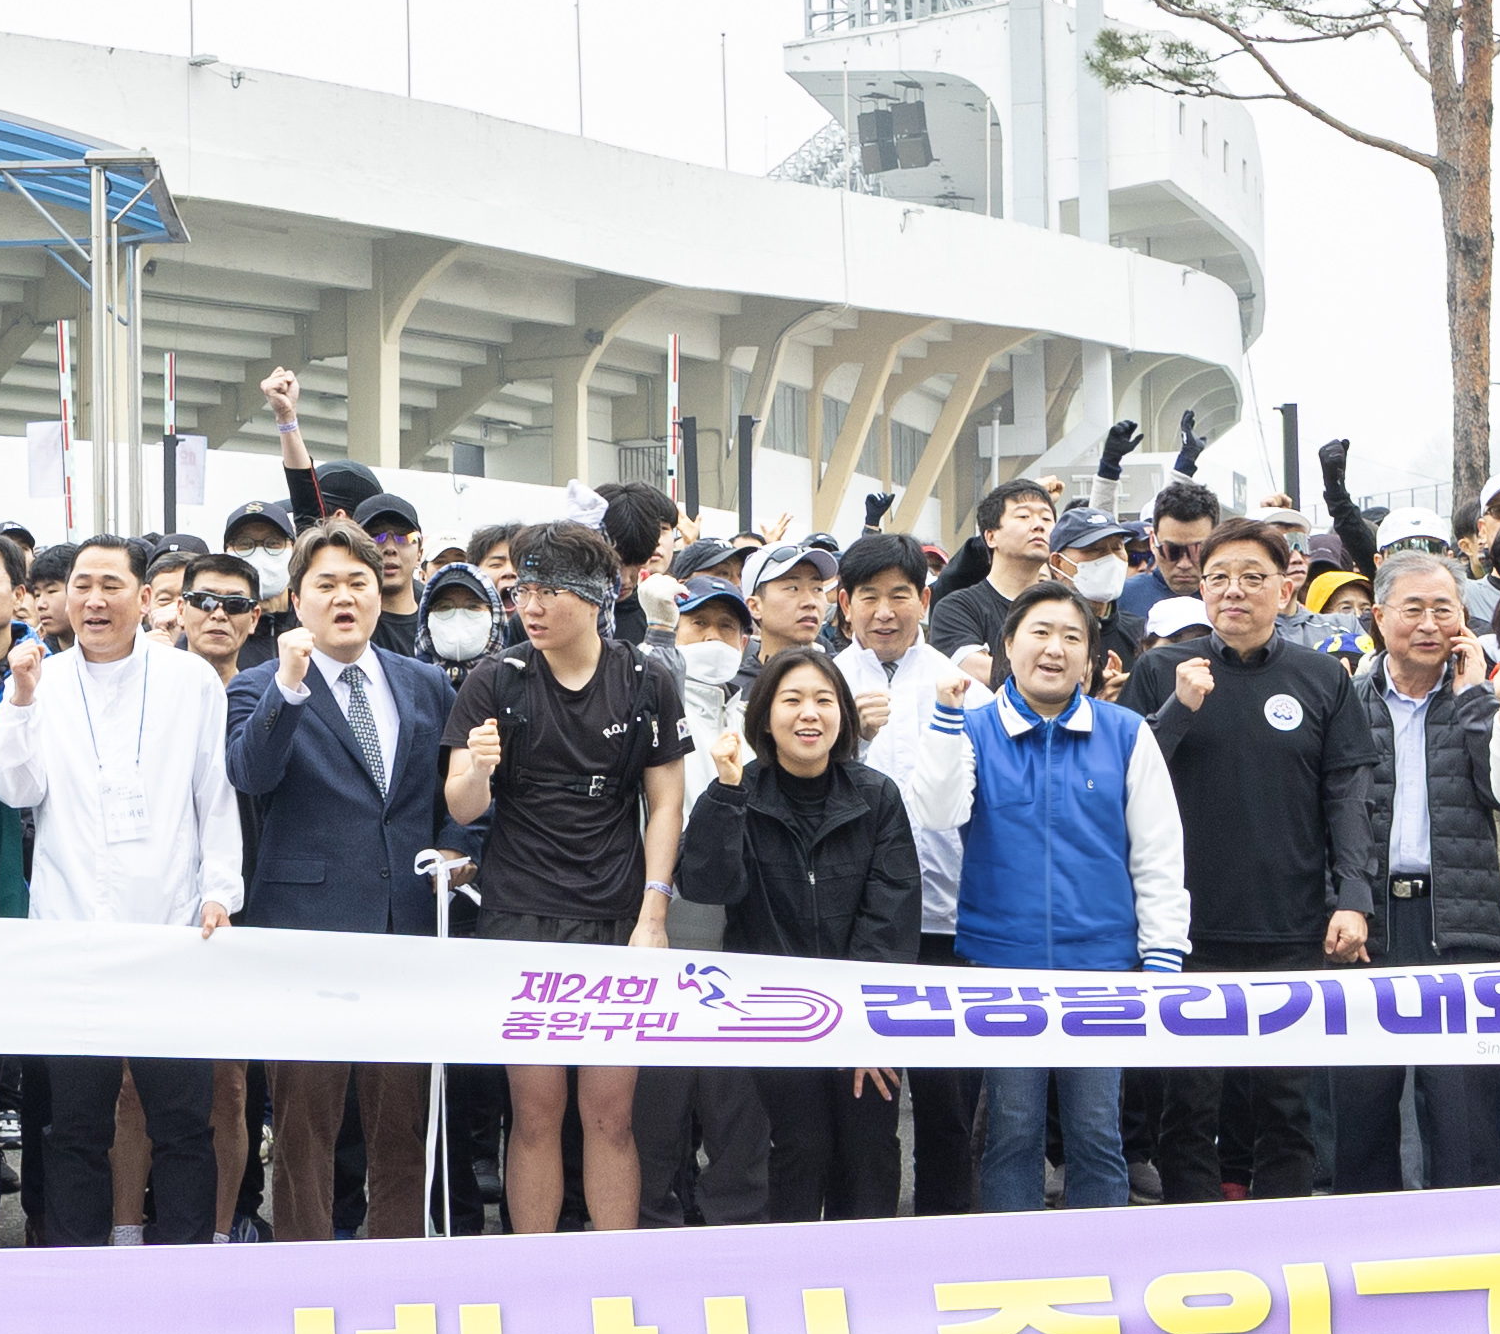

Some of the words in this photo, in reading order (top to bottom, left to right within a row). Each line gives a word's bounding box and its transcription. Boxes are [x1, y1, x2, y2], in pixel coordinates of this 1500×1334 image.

[511, 971, 659, 1006] 제24회
[501, 1010, 679, 1042] 중원구민
[861, 980, 1347, 1037] 건강달리기
